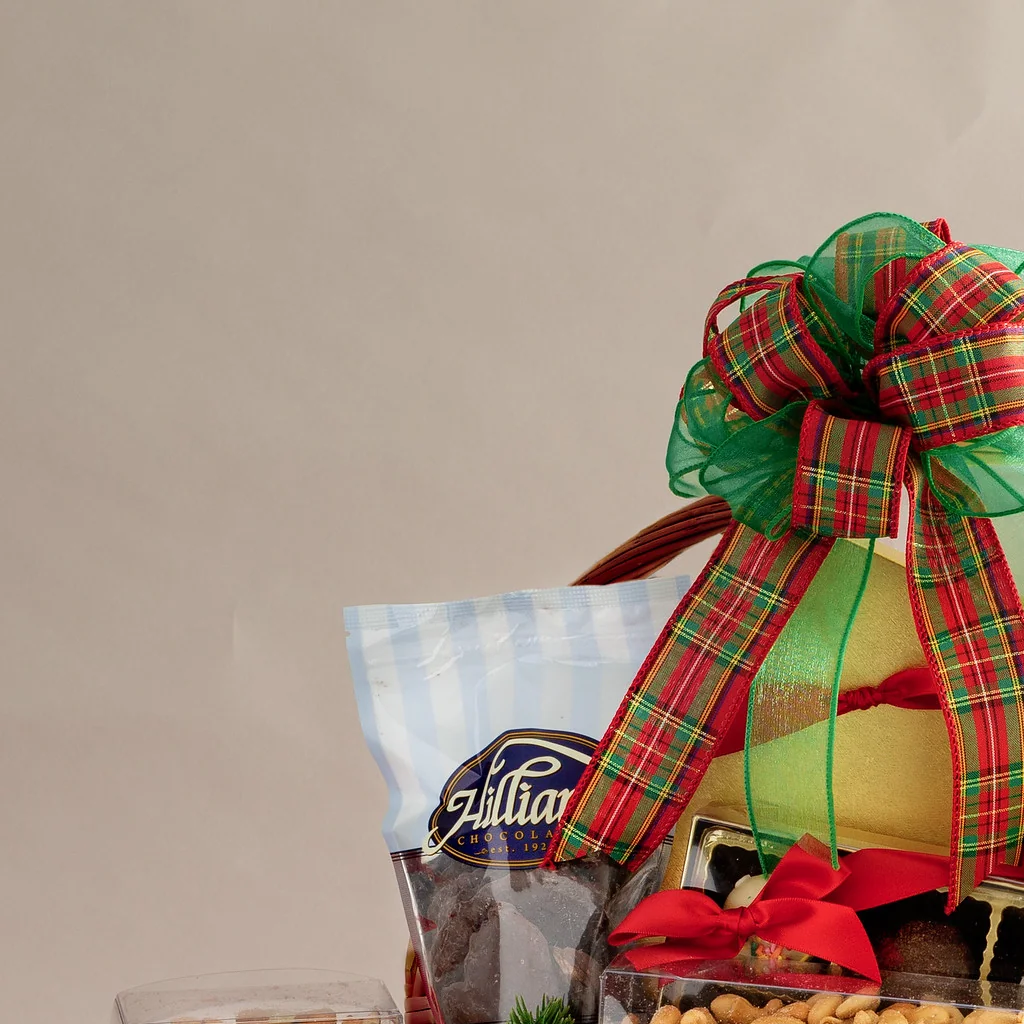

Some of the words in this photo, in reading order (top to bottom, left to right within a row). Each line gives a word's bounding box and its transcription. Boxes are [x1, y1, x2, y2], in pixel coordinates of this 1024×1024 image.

[422, 738, 592, 854] Hilliar
[458, 830, 552, 845] CHOCOLA
[524, 842, 548, 851] 192
